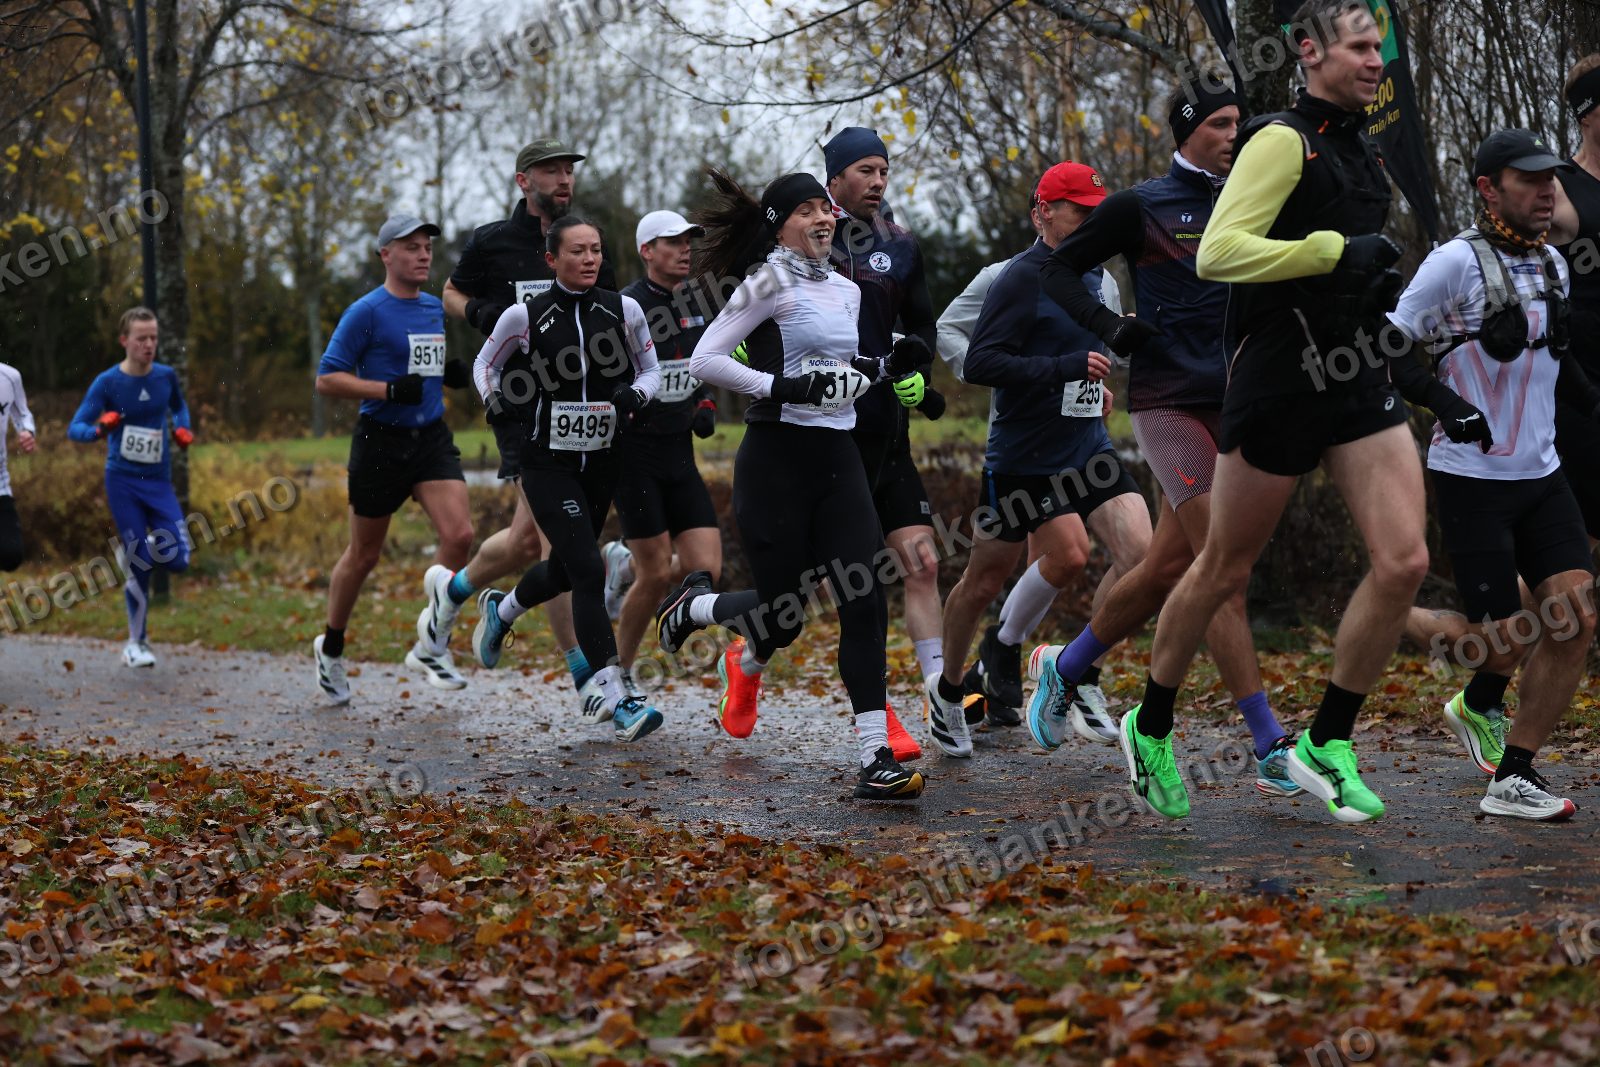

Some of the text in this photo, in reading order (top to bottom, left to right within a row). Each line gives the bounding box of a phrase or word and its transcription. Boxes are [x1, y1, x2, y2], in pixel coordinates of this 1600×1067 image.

[1368, 108, 1400, 136] min/km
[414, 345, 445, 366] 9513
[1075, 380, 1100, 405] 255
[556, 414, 611, 438] 9495
[125, 435, 161, 454] 9514
